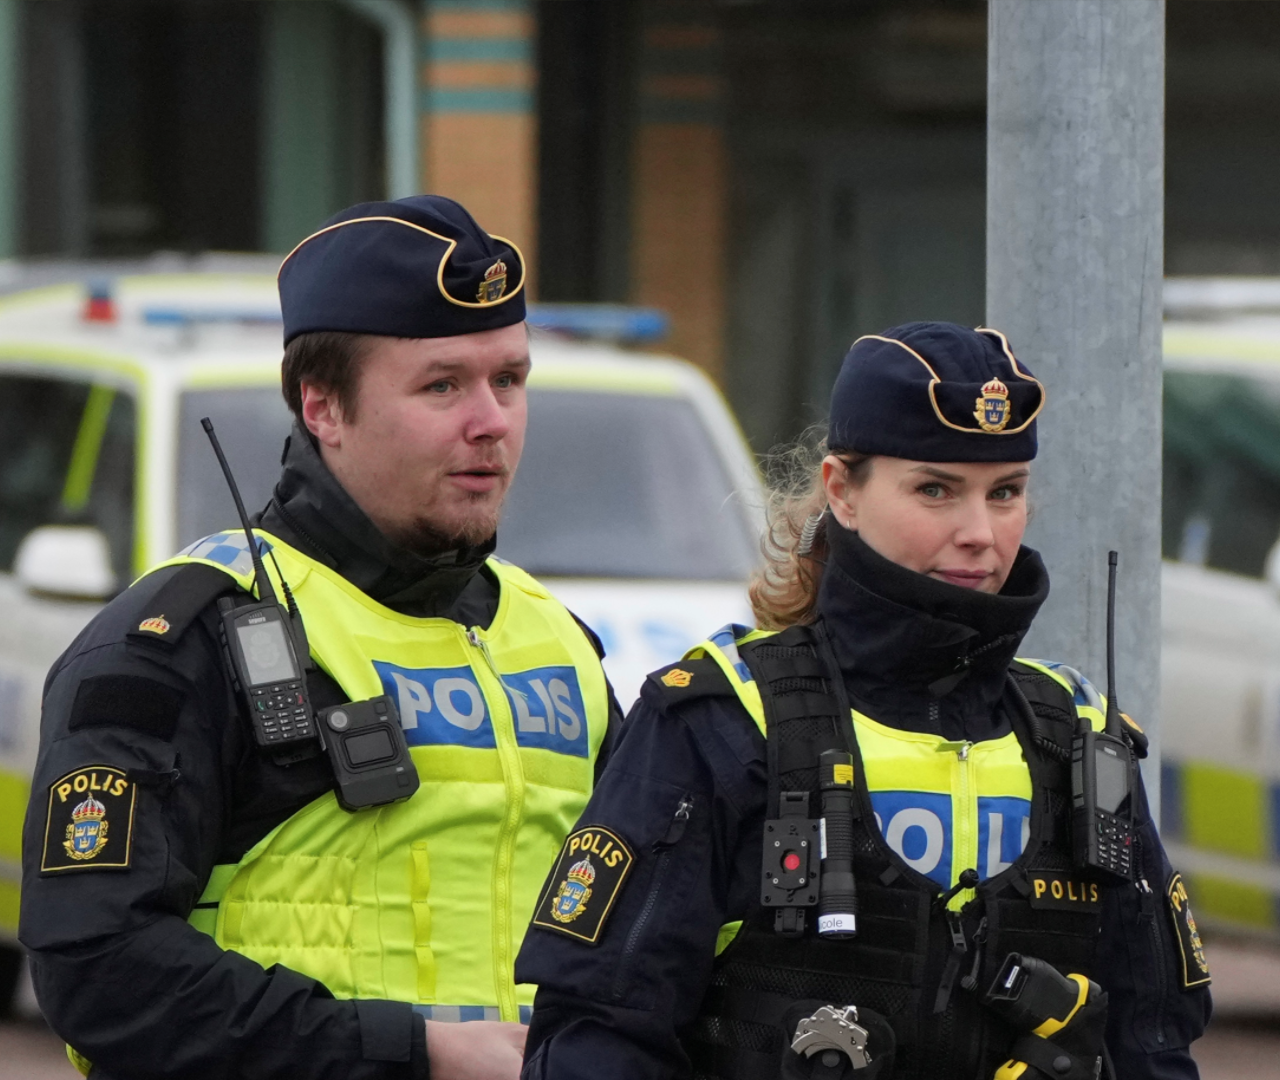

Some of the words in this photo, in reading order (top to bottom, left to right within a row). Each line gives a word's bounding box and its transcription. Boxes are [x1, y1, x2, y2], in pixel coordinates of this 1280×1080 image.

[391, 671, 582, 741] POLIS
[57, 773, 128, 803] POLIS
[569, 832, 624, 868] POLIS
[1033, 879, 1098, 903] POLIS
